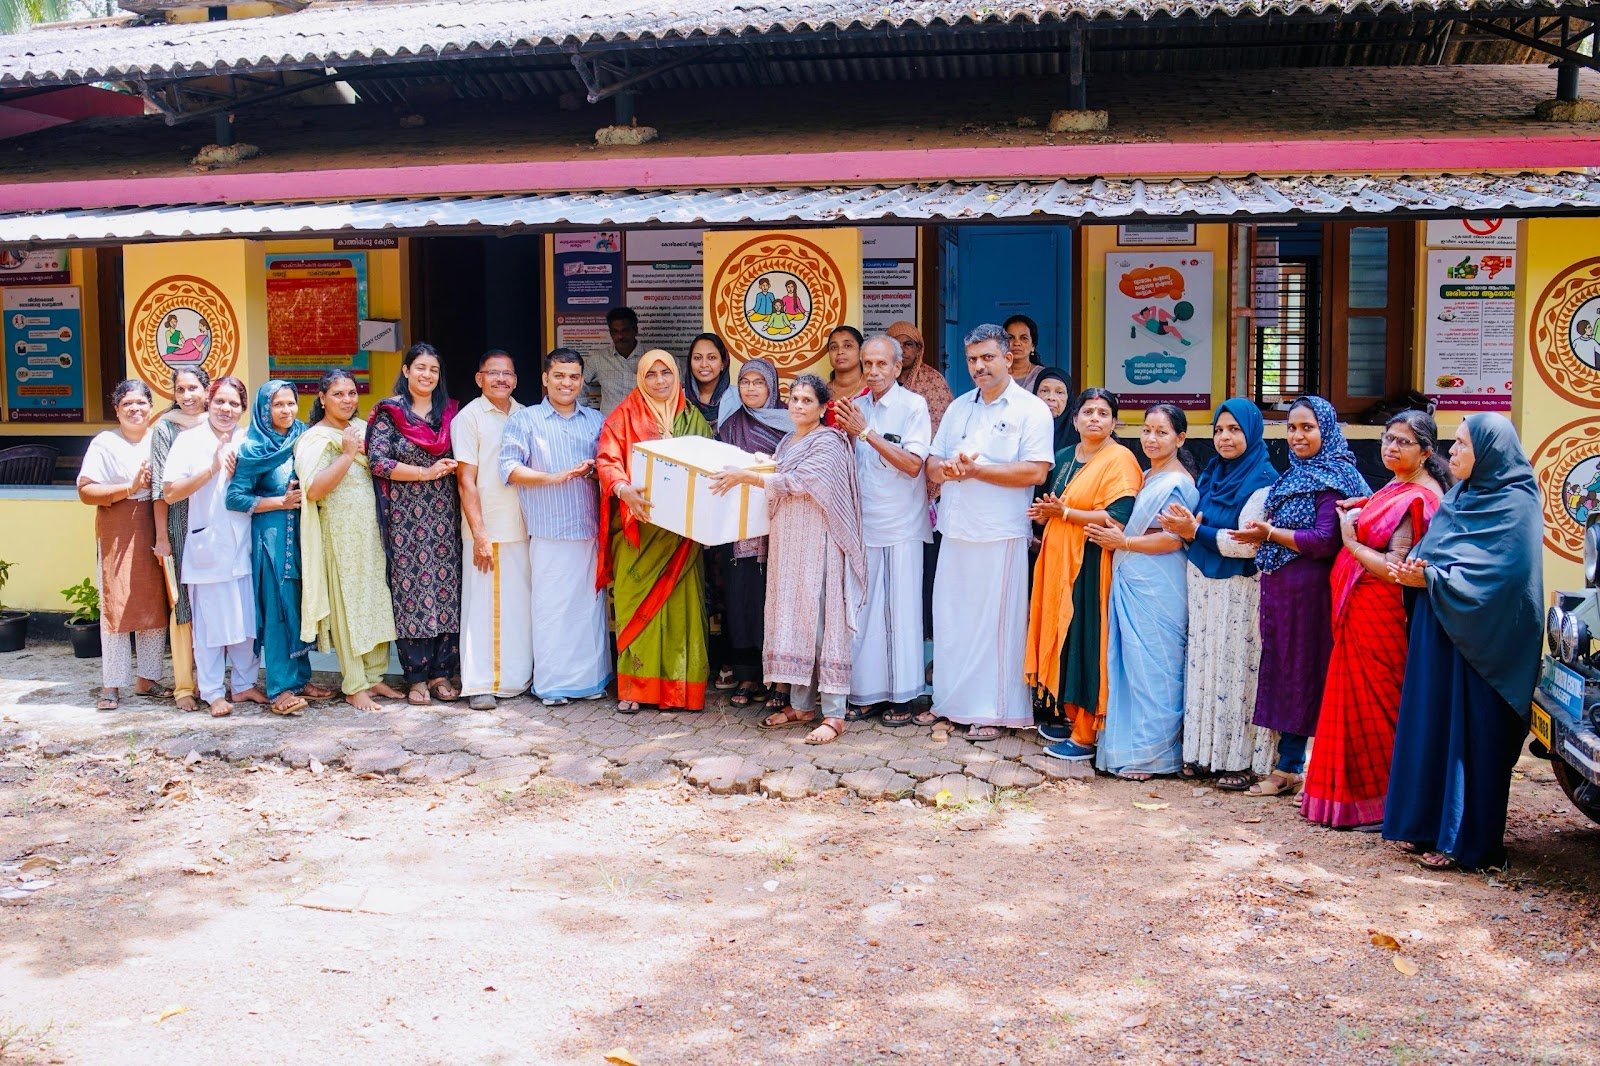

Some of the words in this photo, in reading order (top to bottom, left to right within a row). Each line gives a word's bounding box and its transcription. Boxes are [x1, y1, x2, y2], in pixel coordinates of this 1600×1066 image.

[1446, 289, 1479, 297] ശരിയായ
[361, 338, 374, 349] DOXY
[374, 327, 393, 342] CORNER
